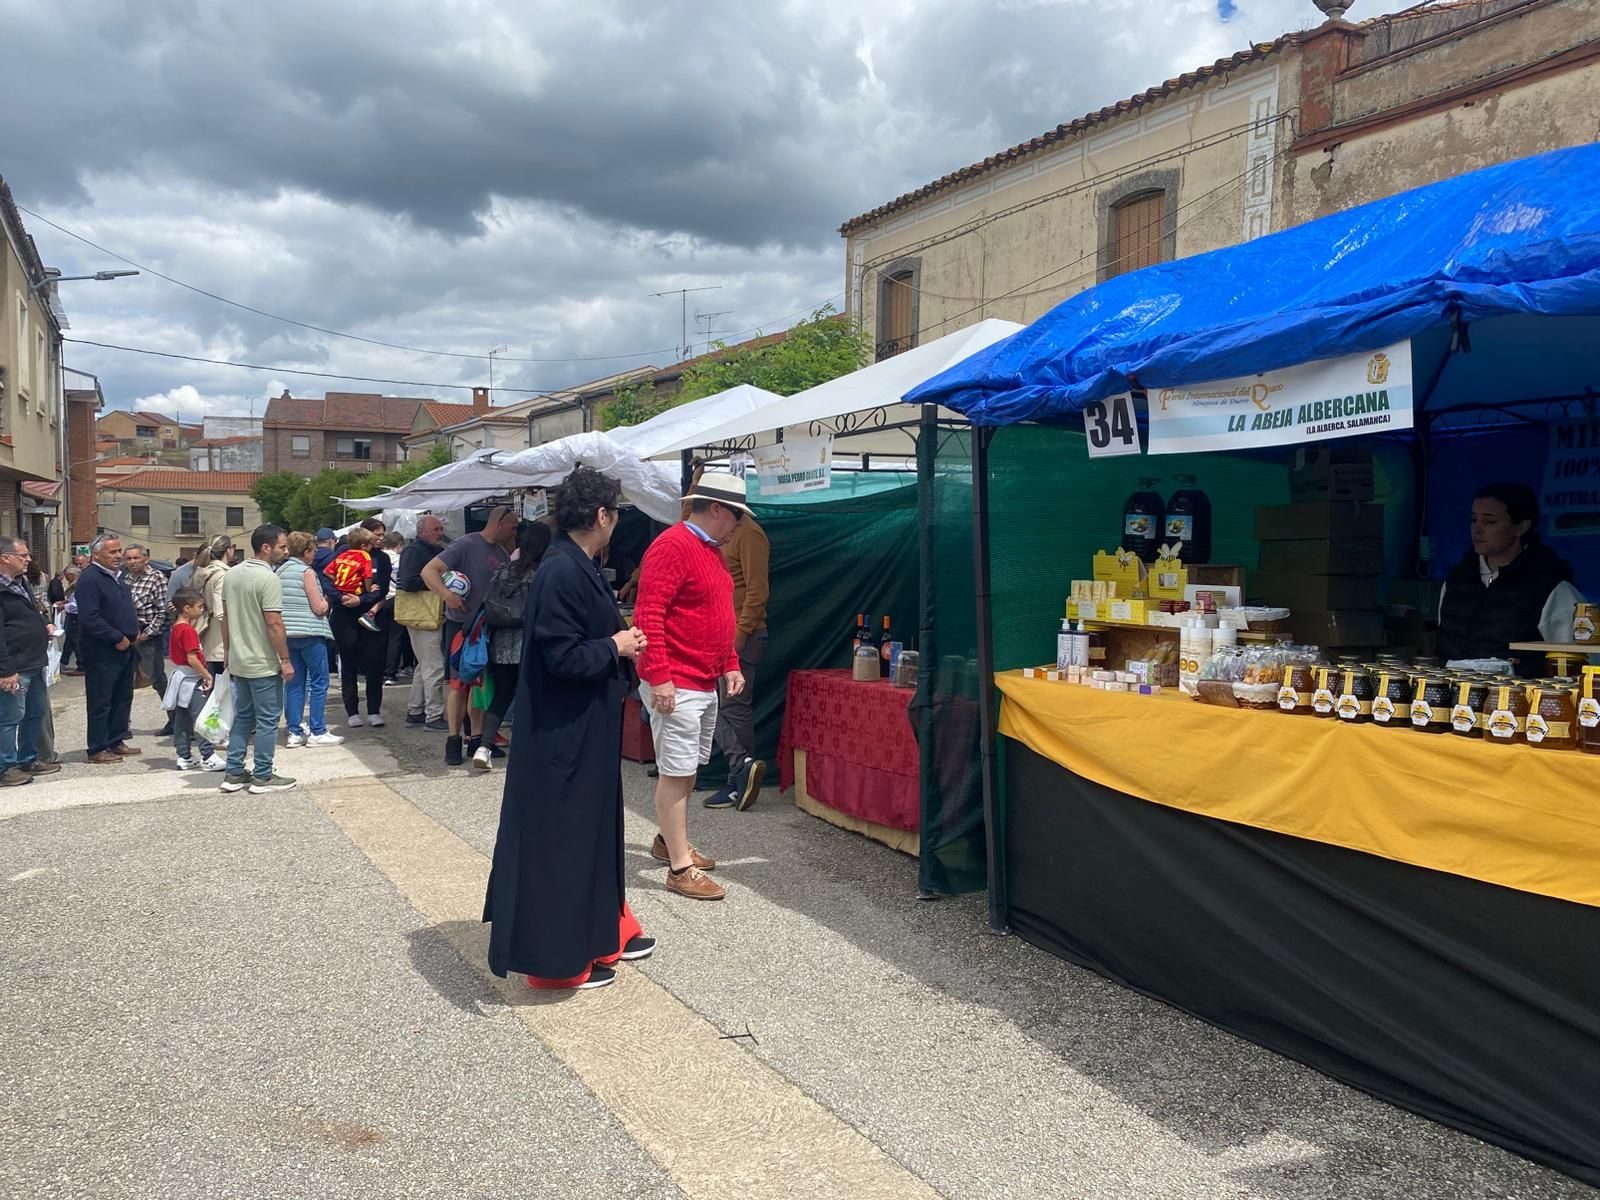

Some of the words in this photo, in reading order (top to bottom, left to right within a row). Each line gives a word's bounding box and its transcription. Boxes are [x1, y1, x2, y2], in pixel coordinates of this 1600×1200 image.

[1086, 398, 1134, 448] 34
[1228, 414, 1247, 432] LA
[1250, 408, 1293, 431] ABEJA
[1297, 390, 1390, 424] ALBERCANA
[1316, 420, 1346, 433] ALBERCA,
[1347, 414, 1391, 429] SALAMANCA)
